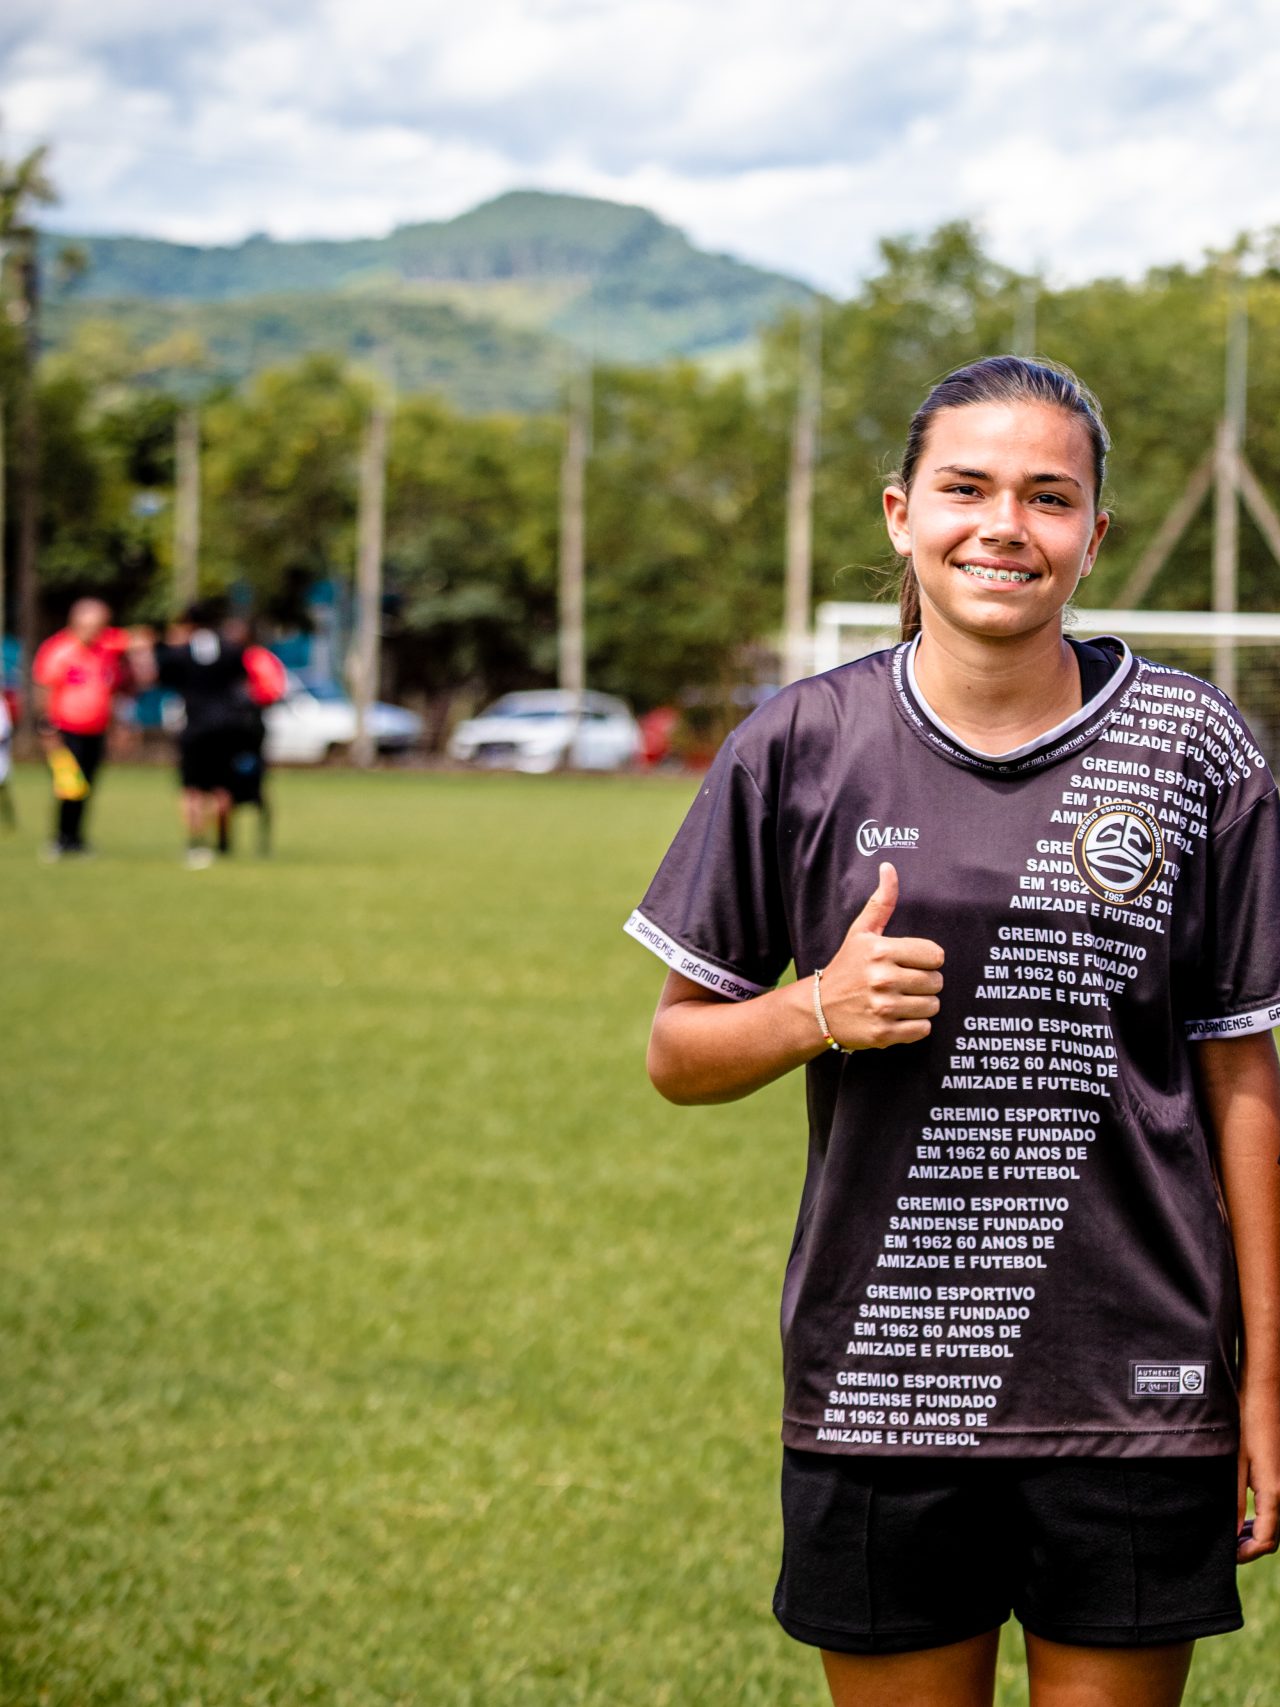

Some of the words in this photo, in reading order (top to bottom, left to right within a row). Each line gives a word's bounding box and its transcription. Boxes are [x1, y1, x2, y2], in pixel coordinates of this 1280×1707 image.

[1120, 697, 1205, 722] SANDENSE
[1111, 711, 1134, 727] EM
[1139, 717, 1176, 735] 1962
[1181, 723, 1198, 739] 60
[1201, 694, 1265, 768] ESPORTIVO
[1099, 728, 1171, 752] AMIZADE
[1176, 741, 1187, 755] E
[1082, 757, 1150, 777] GREMIO
[1070, 775, 1159, 800] SANDENSE
[1062, 792, 1087, 806] EM
[1189, 820, 1207, 840] DE
[1100, 804, 1144, 818] ESPORTIVO
[1145, 817, 1163, 859] SANDENSE
[1036, 840, 1073, 856] GRE
[1019, 876, 1045, 891] EM
[1050, 879, 1090, 895] 1962
[1104, 890, 1125, 903] 1962
[1009, 895, 1087, 914] AMIZADE
[1091, 903, 1100, 917] E
[1104, 906, 1166, 934] FUTEBOL
[998, 926, 1067, 945] GREMIO
[635, 922, 676, 960] SANDENSE
[681, 957, 720, 986] GRÊMIO
[989, 947, 1079, 967] SANDENSE
[984, 966, 1009, 979] EM
[1014, 966, 1054, 982] 1962
[1057, 971, 1076, 985] 60
[1105, 978, 1126, 995] DE
[975, 985, 1052, 1001] AMIZADE
[1056, 989, 1066, 1003] E
[964, 1017, 1033, 1032] GREMIO
[1205, 1015, 1254, 1033] SANDENSE
[955, 1037, 1047, 1051] SANDENSE
[950, 1056, 975, 1069] EM
[980, 1056, 1020, 1070] 1962
[1024, 1057, 1044, 1070] 60
[1049, 1057, 1092, 1075] ANOS
[1096, 1063, 1118, 1078] DE
[941, 1075, 1017, 1090] AMIZADE
[1022, 1076, 1033, 1090] E
[1037, 1076, 1111, 1097] FUTEBOL
[929, 1107, 999, 1122] GREMIO
[1004, 1108, 1100, 1124] ESPORTIVO
[922, 1127, 1012, 1141] SANDENSE
[1017, 1128, 1096, 1142] FUNDADO
[916, 1146, 941, 1159] EM
[946, 1146, 986, 1160] 1962
[990, 1147, 1010, 1160] 60
[1014, 1147, 1061, 1161] ANOS
[1066, 1147, 1087, 1160] DE
[907, 1165, 983, 1179] AMIZADE
[988, 1167, 999, 1179] E
[1003, 1166, 1080, 1180] FUTEBOL
[897, 1197, 965, 1211] GREMIO
[971, 1197, 1069, 1212] ESPORTIVO
[889, 1216, 979, 1231] SANDENSE
[983, 1217, 1064, 1231] FUNDADO
[884, 1235, 908, 1249] EM
[912, 1235, 952, 1249] 1962
[956, 1236, 976, 1250] 60
[981, 1236, 1028, 1250] ANOS
[1032, 1236, 1055, 1250] DE
[876, 1254, 950, 1269] AMIZADE
[954, 1255, 965, 1269] E
[970, 1255, 1047, 1269] FUTEBOL
[866, 1284, 932, 1300] GREMIO
[937, 1287, 1036, 1301] ESPORTIVO
[859, 1304, 945, 1320] SANDENSE
[950, 1307, 1030, 1321] FUNDADO
[854, 1322, 876, 1337] EM
[880, 1324, 919, 1338] 1962
[922, 1325, 943, 1338] 60
[947, 1325, 995, 1339] ANOS
[999, 1325, 1022, 1339] DE
[846, 1341, 917, 1357] AMIZADE
[920, 1344, 931, 1357] E
[936, 1344, 1014, 1358] FUTEBOL
[836, 1371, 899, 1388] GREMIO
[903, 1374, 1002, 1389] ESPORTIVO
[1137, 1369, 1180, 1377] AUTHENTIC
[828, 1390, 912, 1407] SANDENSE
[916, 1394, 997, 1408] FUNDADO
[823, 1409, 845, 1423] EM
[849, 1410, 885, 1425] 1962
[889, 1411, 909, 1426] 60
[913, 1412, 960, 1426] ANOS
[965, 1413, 988, 1427] DE
[816, 1427, 882, 1444] AMIZADE
[886, 1431, 898, 1444] E
[902, 1431, 980, 1446] FUTEBOL
